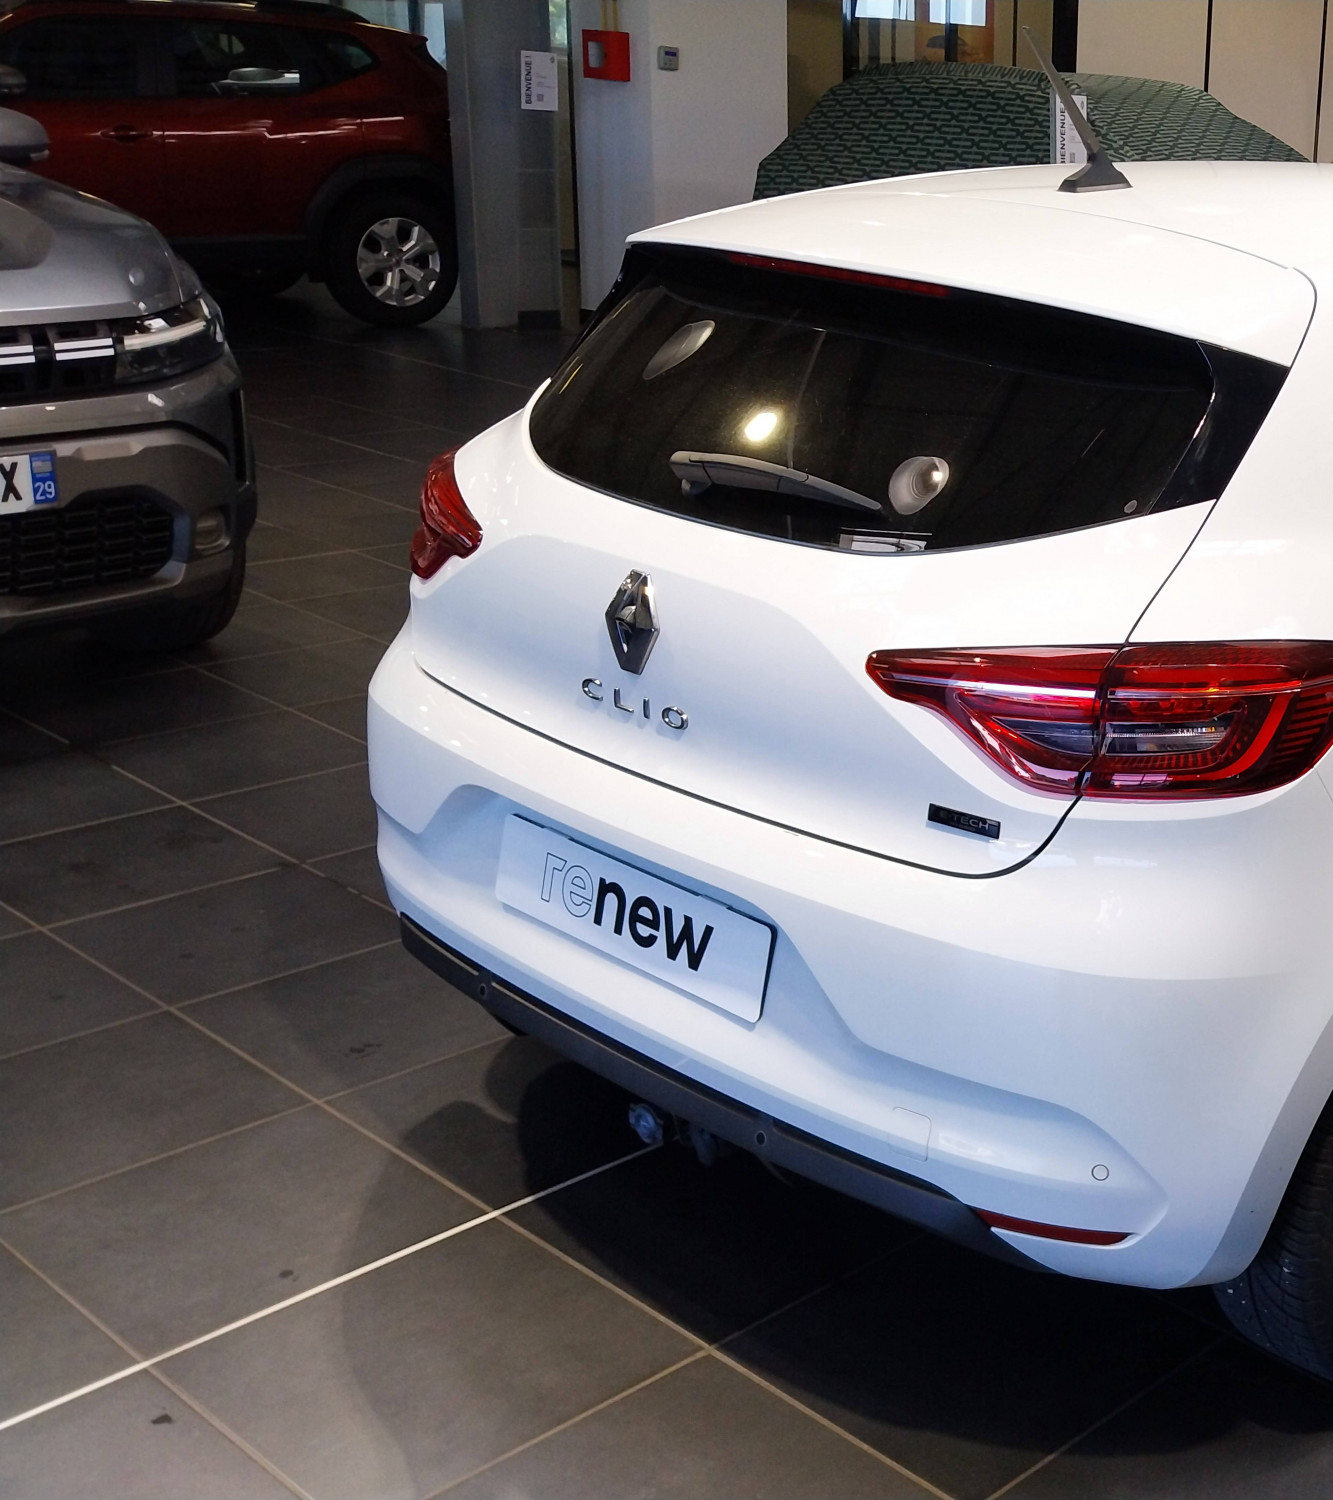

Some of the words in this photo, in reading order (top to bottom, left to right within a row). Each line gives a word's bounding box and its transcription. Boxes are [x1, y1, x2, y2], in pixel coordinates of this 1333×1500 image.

[34, 481, 55, 500] 29
[582, 678, 688, 730] CLIO
[541, 852, 715, 972] renew
